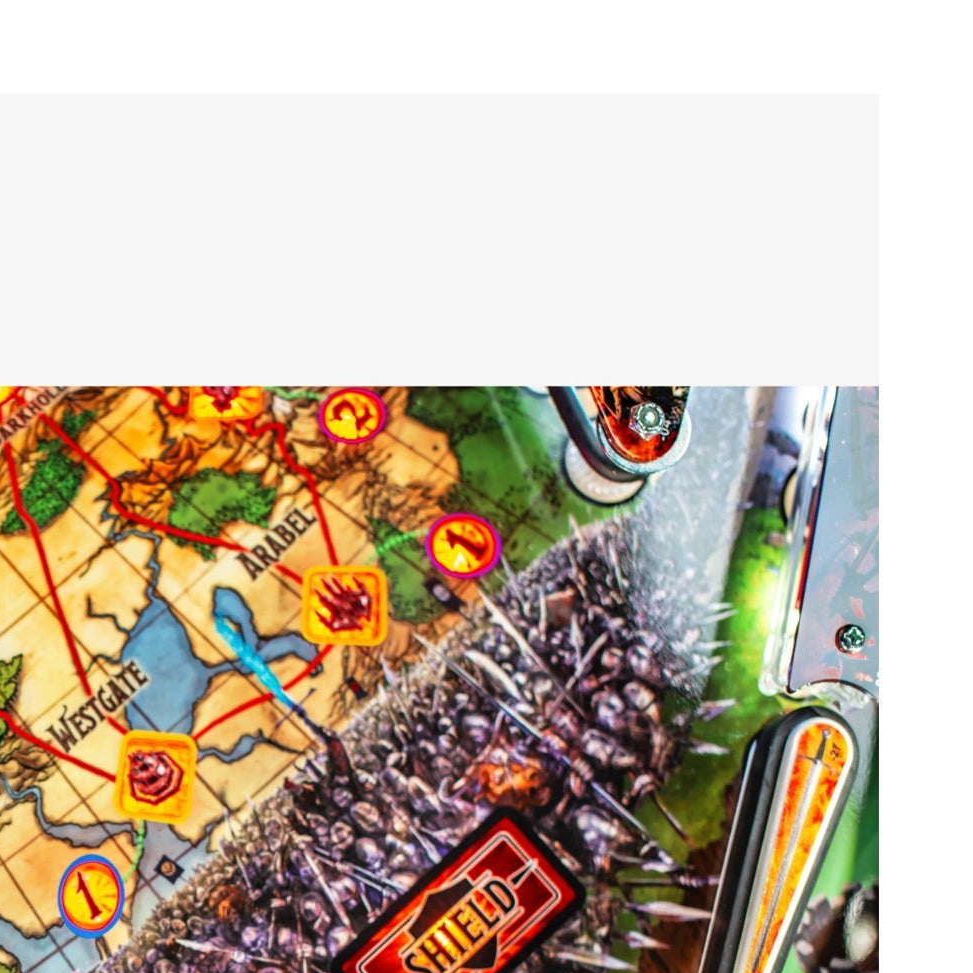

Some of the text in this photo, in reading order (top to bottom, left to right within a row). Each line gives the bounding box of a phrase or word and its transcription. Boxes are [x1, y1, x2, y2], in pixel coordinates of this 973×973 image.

[235, 508, 317, 582] ARABEL
[45, 659, 149, 754] WESTGATE
[76, 871, 102, 919] 1
